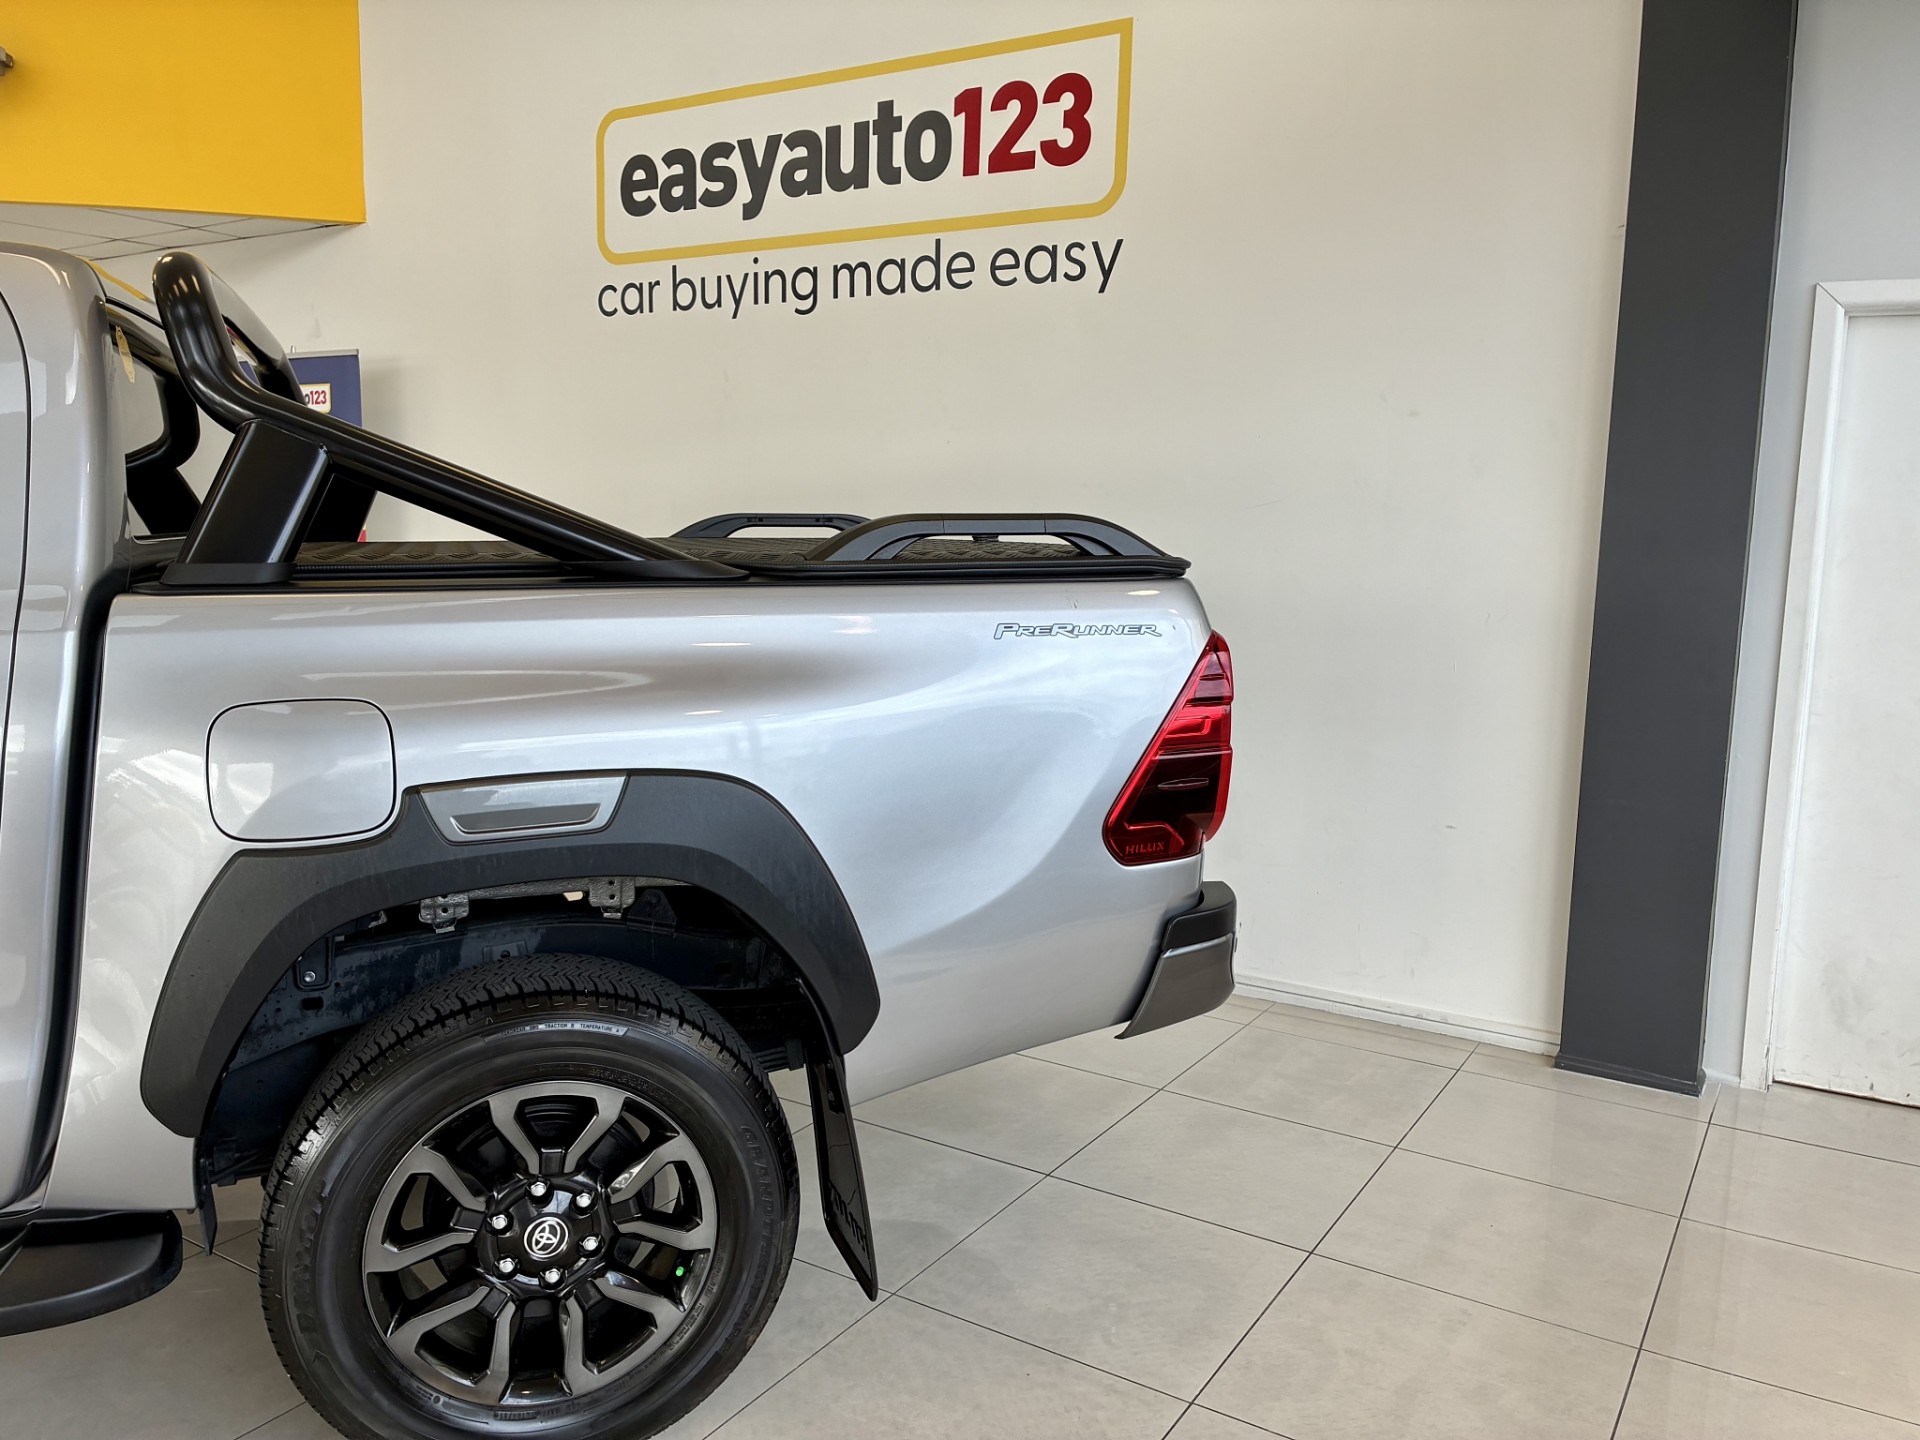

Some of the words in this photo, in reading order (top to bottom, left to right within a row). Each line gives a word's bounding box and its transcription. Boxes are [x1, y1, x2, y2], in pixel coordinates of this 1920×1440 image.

[620, 72, 1093, 221] easyauto123
[598, 277, 660, 317] car
[671, 257, 818, 319] buying
[832, 239, 976, 299] made
[990, 239, 1123, 293] easy
